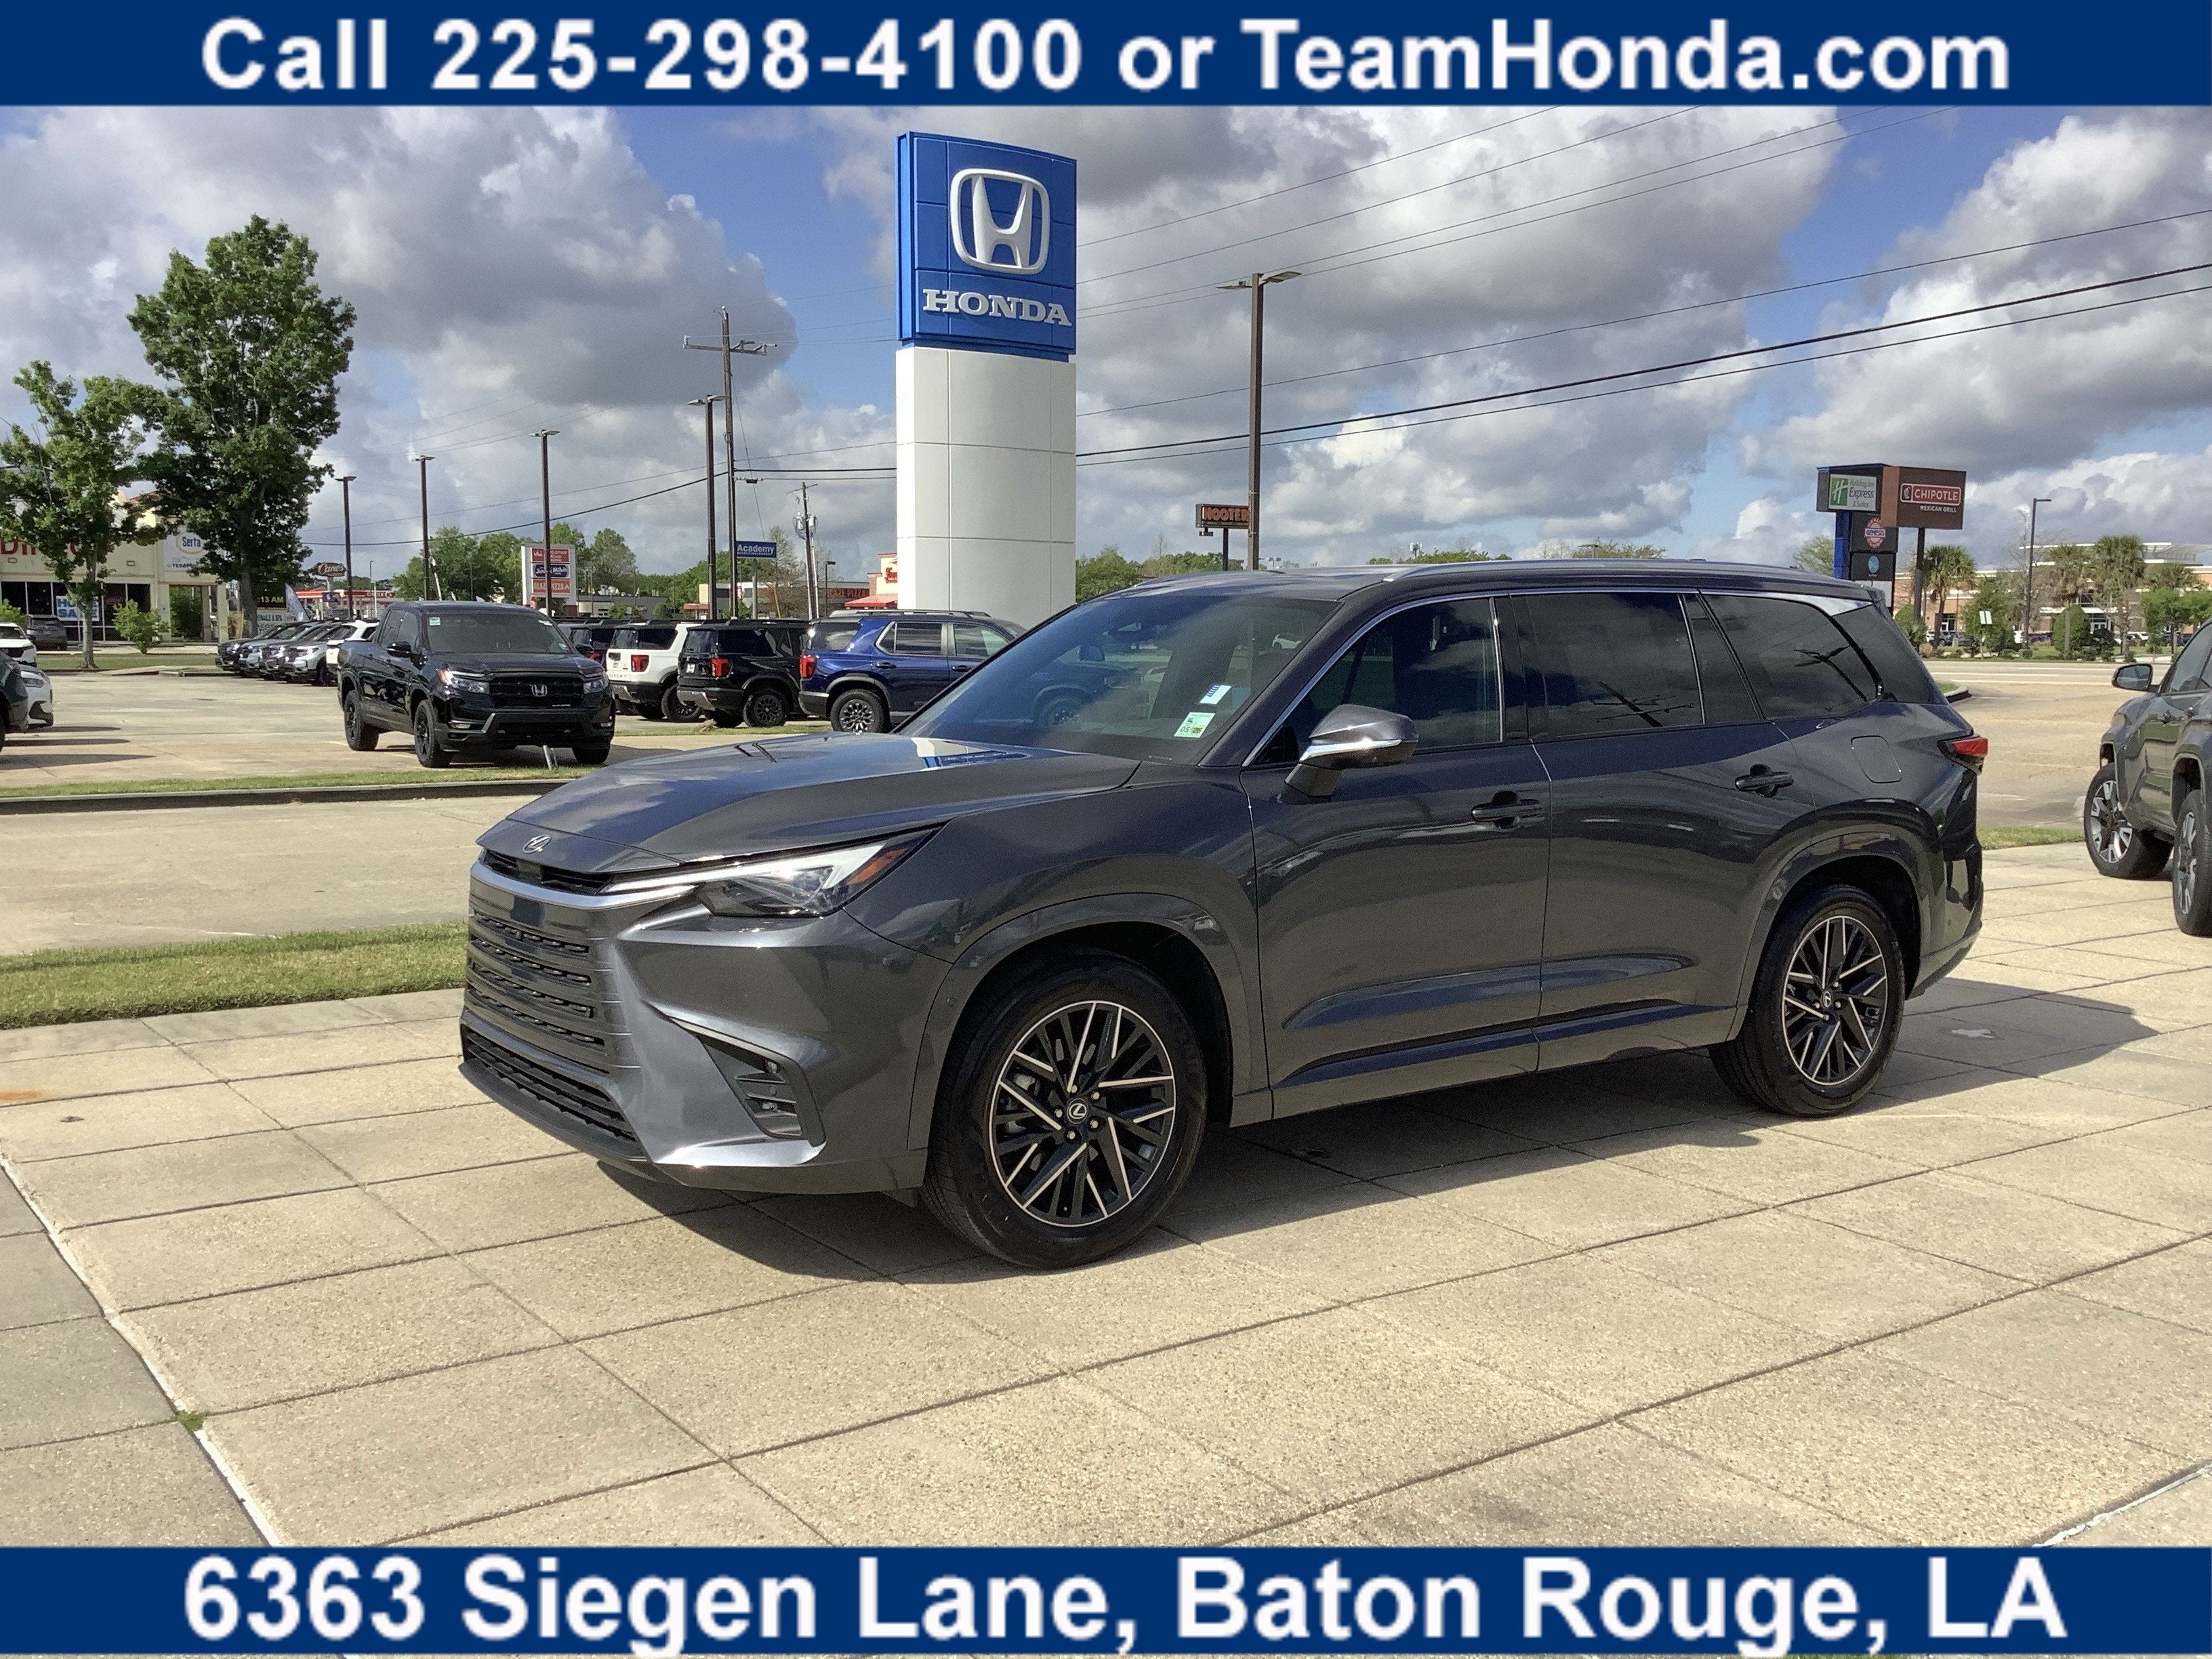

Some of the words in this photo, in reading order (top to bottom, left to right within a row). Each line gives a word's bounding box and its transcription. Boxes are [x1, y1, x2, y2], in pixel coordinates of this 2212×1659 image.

[922, 289, 1072, 326] HONDA
[1849, 487, 1875, 499] Express
[1914, 489, 1959, 501] CHIPOTLE
[1204, 507, 1250, 522] HOOTER
[182, 536, 201, 547] Serta
[737, 544, 775, 554] Academy
